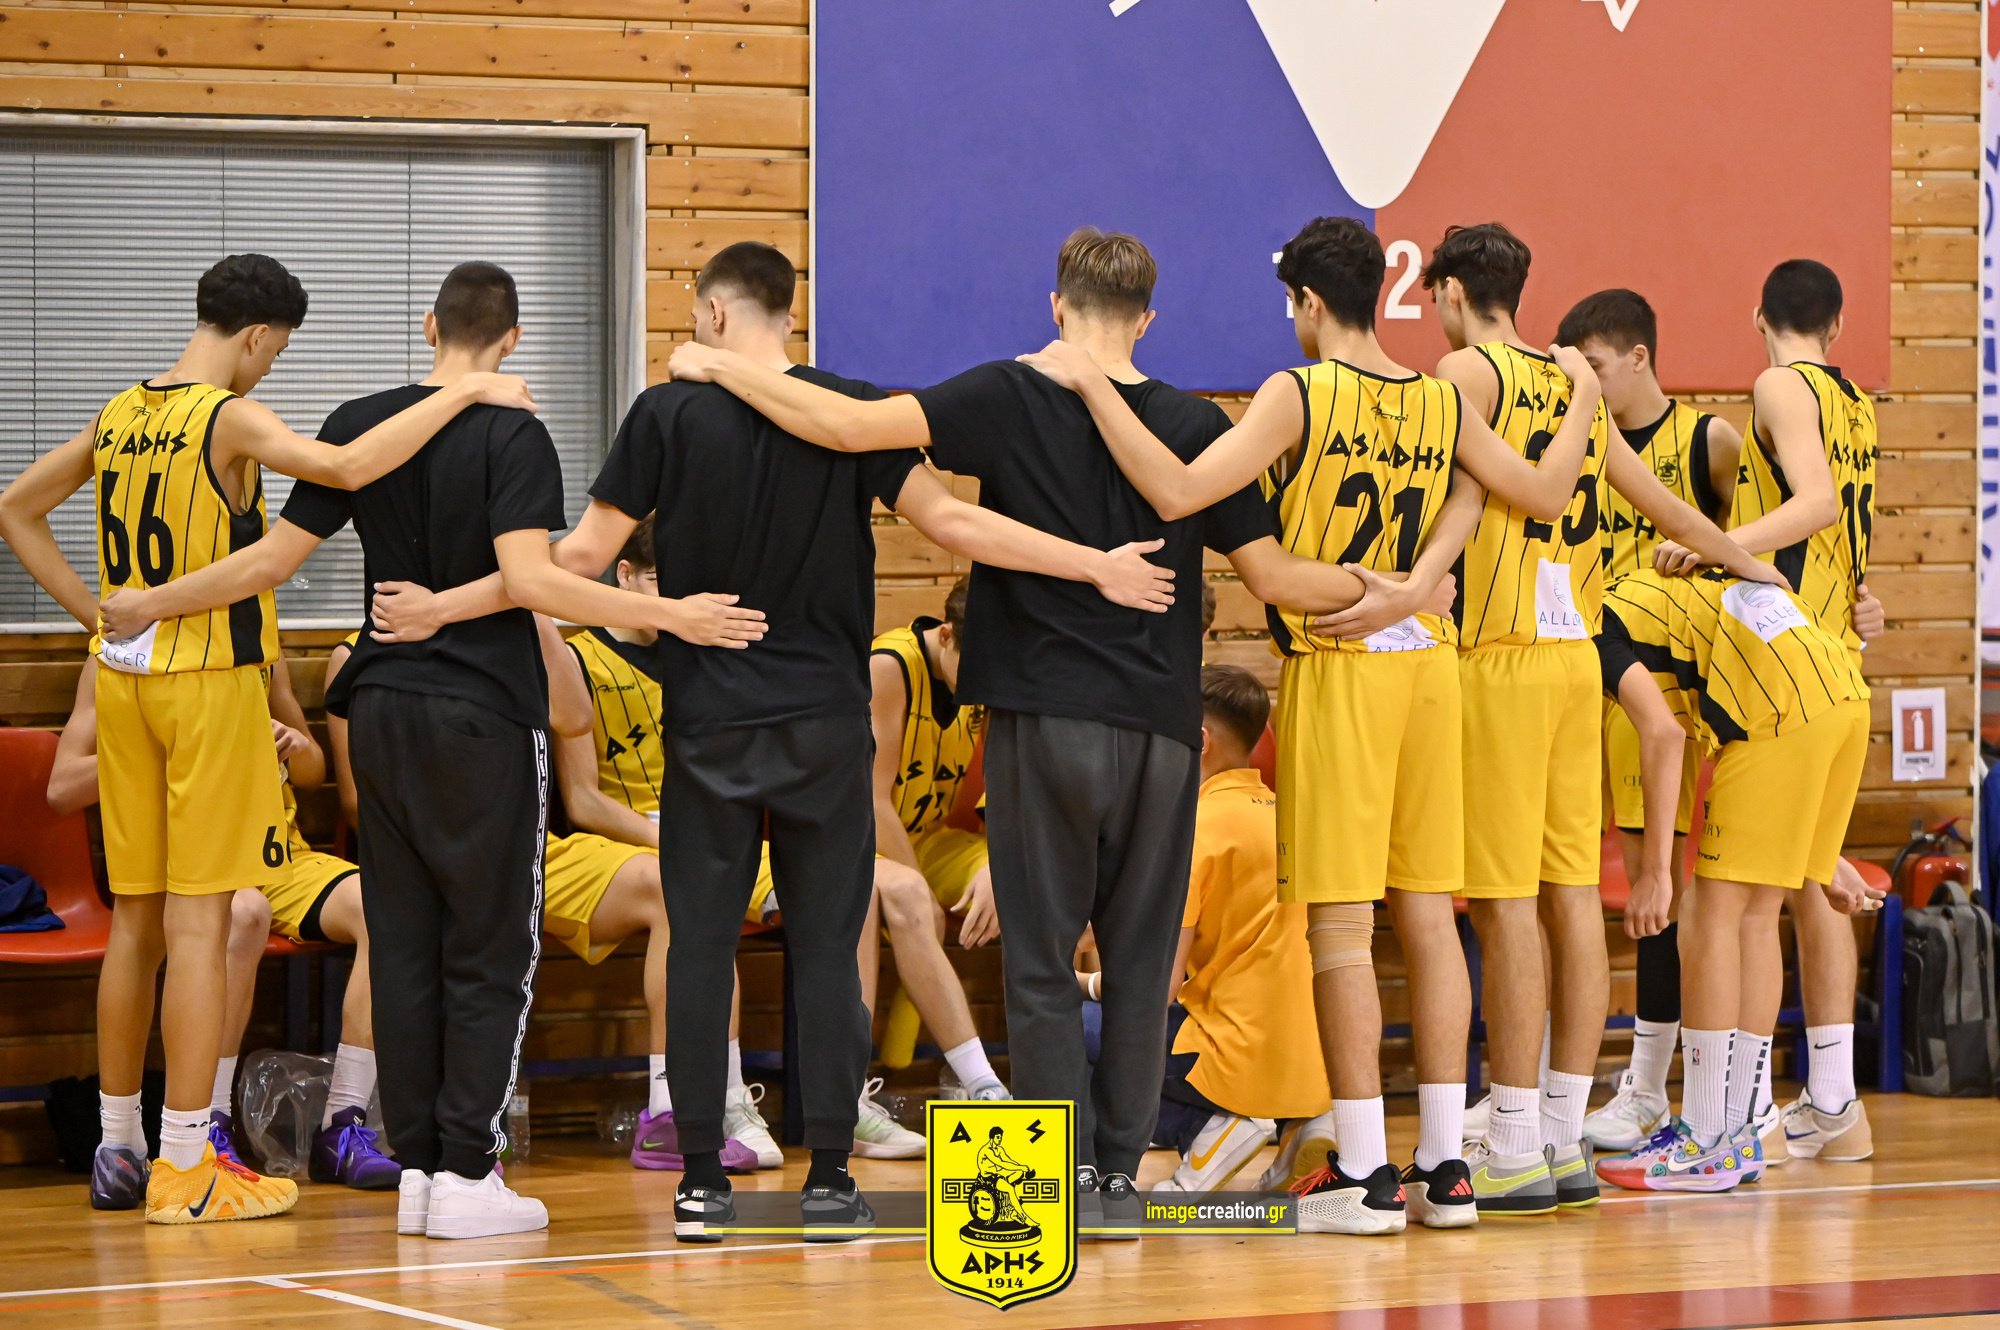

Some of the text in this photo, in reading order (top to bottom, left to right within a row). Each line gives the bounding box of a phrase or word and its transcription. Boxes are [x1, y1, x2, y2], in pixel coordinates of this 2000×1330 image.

[101, 469, 174, 588] 66
[1335, 472, 1426, 573] 21
[691, 1189, 710, 1199] NIKE
